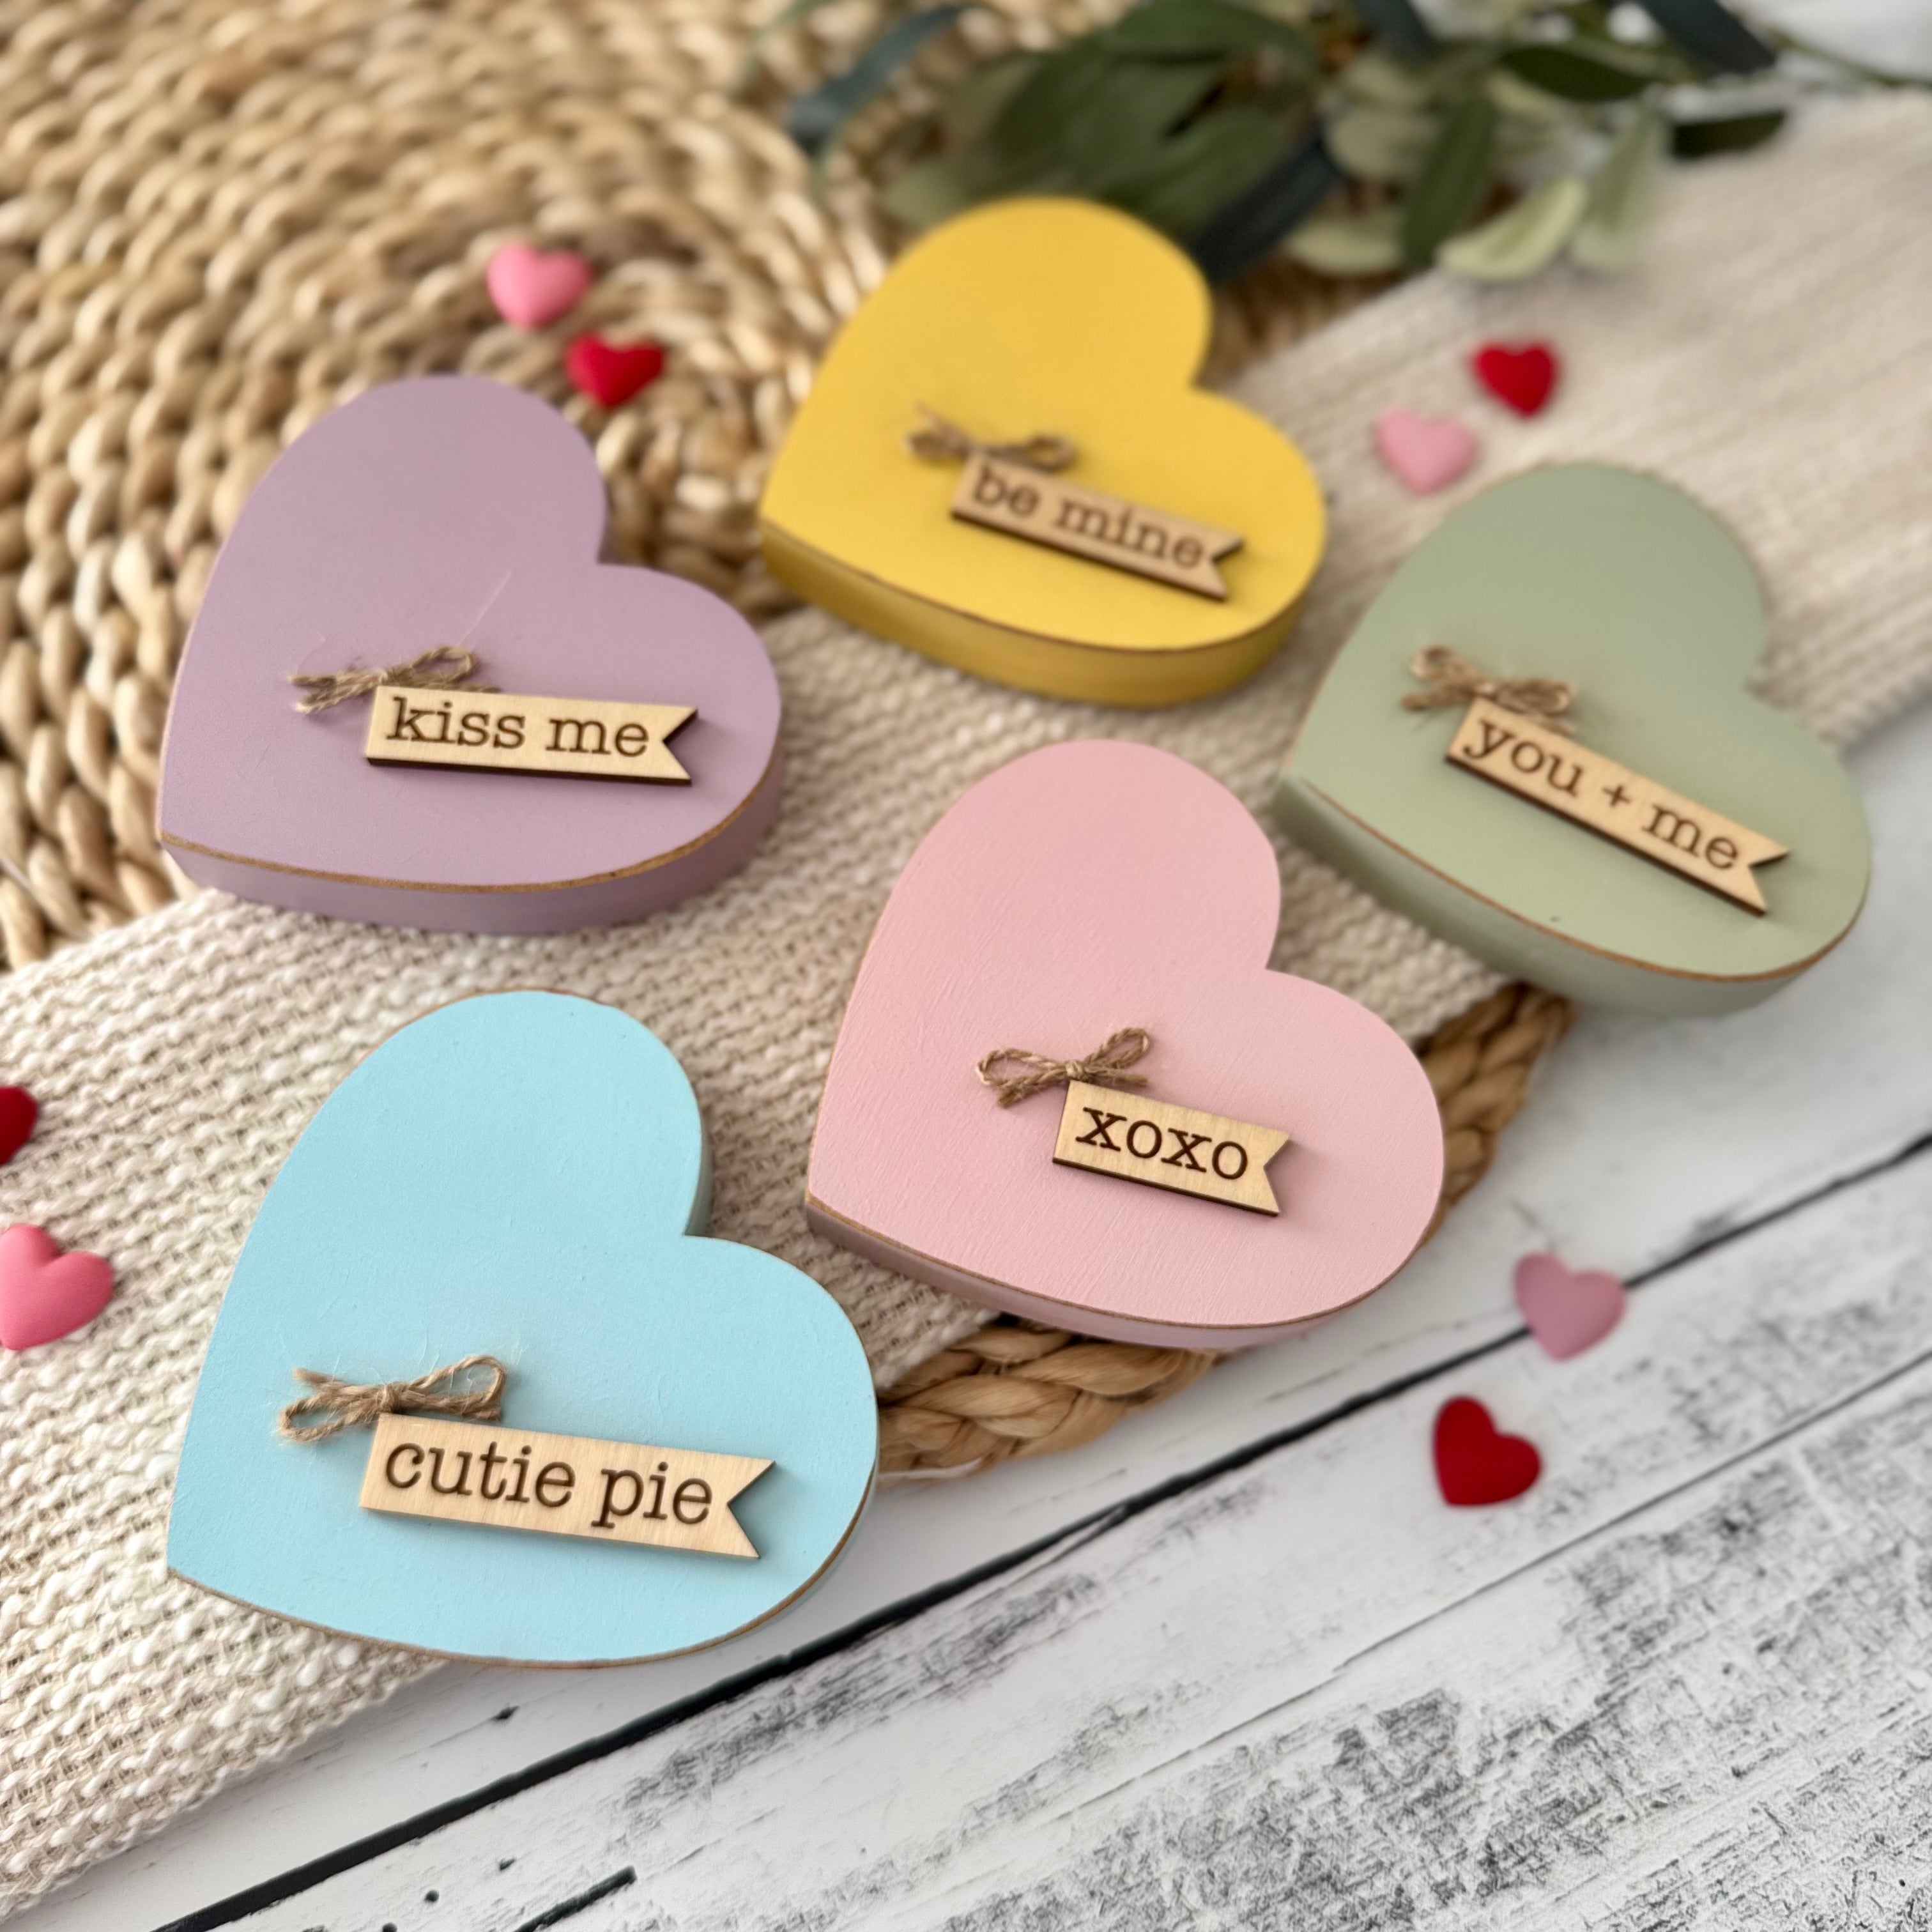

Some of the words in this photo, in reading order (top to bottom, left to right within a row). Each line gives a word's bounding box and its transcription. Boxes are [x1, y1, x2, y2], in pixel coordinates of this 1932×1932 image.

[972, 463, 1039, 516] be
[1055, 498, 1204, 568] mine
[386, 696, 526, 749] kiss
[545, 717, 649, 758] me
[1462, 719, 1584, 797] you
[1601, 783, 1632, 808] +
[1641, 803, 1738, 870] me
[1075, 1107, 1248, 1180] xoxo
[385, 1441, 576, 1508] cutie
[591, 1461, 712, 1529] pie
